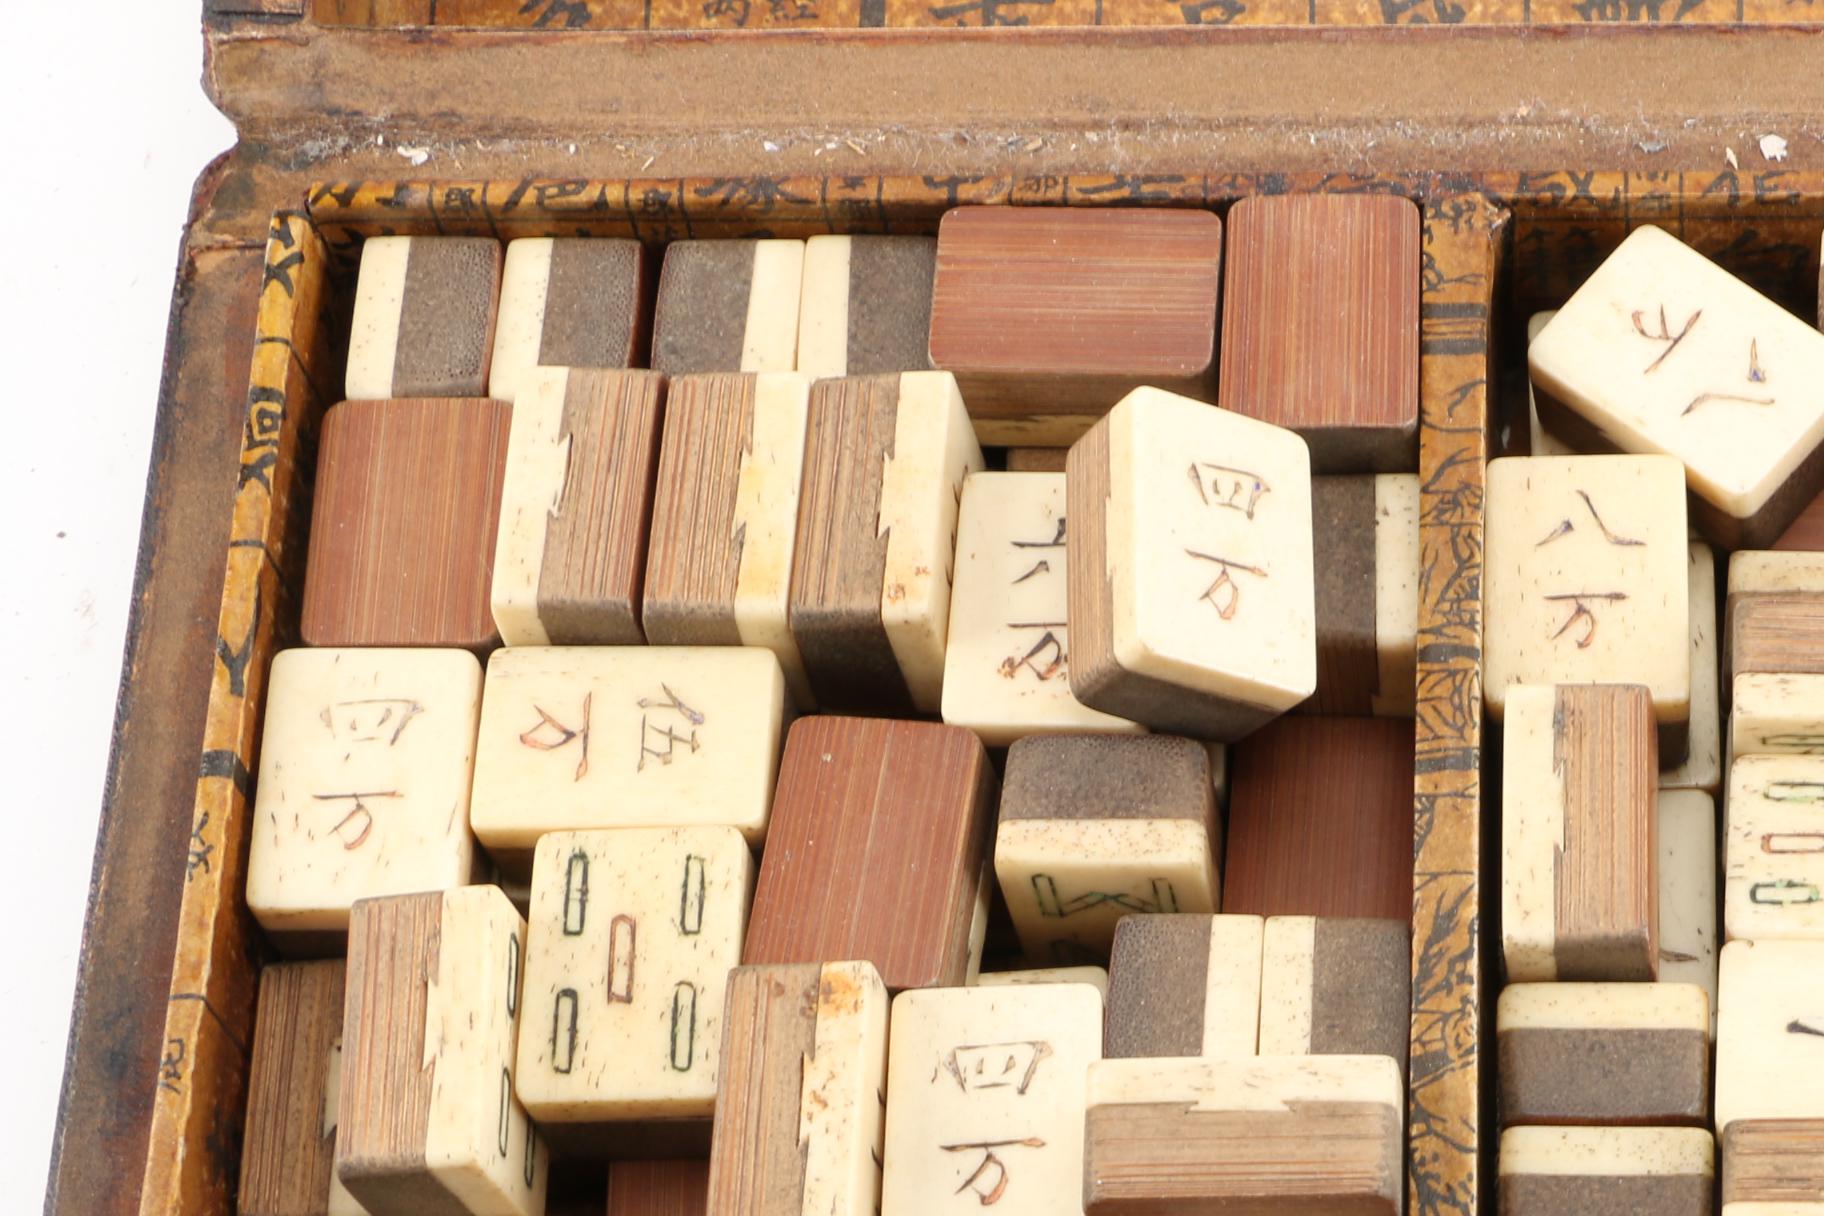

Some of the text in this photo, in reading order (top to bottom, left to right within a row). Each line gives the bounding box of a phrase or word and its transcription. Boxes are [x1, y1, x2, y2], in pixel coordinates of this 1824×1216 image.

[1183, 460, 1271, 622] 四万
[1535, 488, 1648, 650] 八万
[938, 1040, 1055, 1207] 四万
